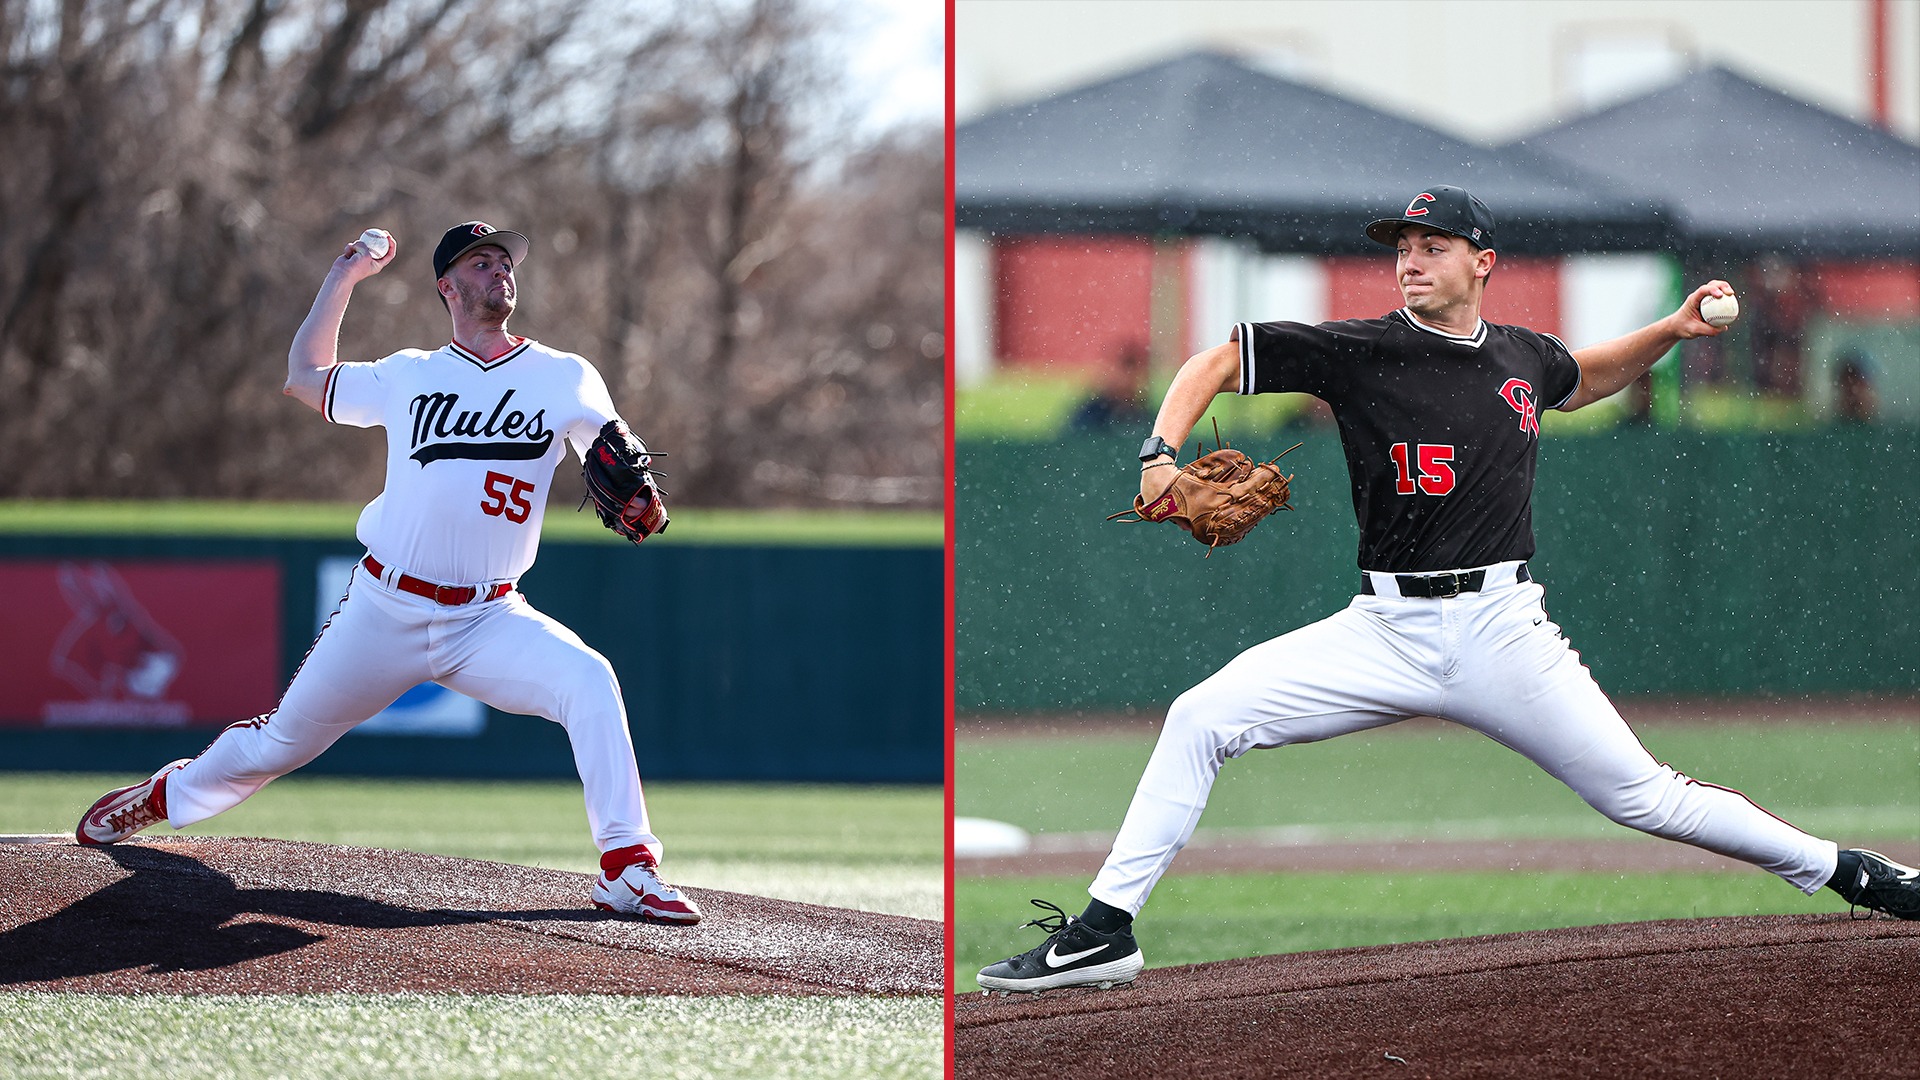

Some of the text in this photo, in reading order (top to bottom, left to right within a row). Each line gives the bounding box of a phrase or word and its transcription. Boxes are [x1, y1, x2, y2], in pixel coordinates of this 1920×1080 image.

[1405, 192, 1437, 217] C
[410, 389, 552, 451] Mules
[1389, 442, 1456, 497] 15
[480, 471, 535, 525] 55
